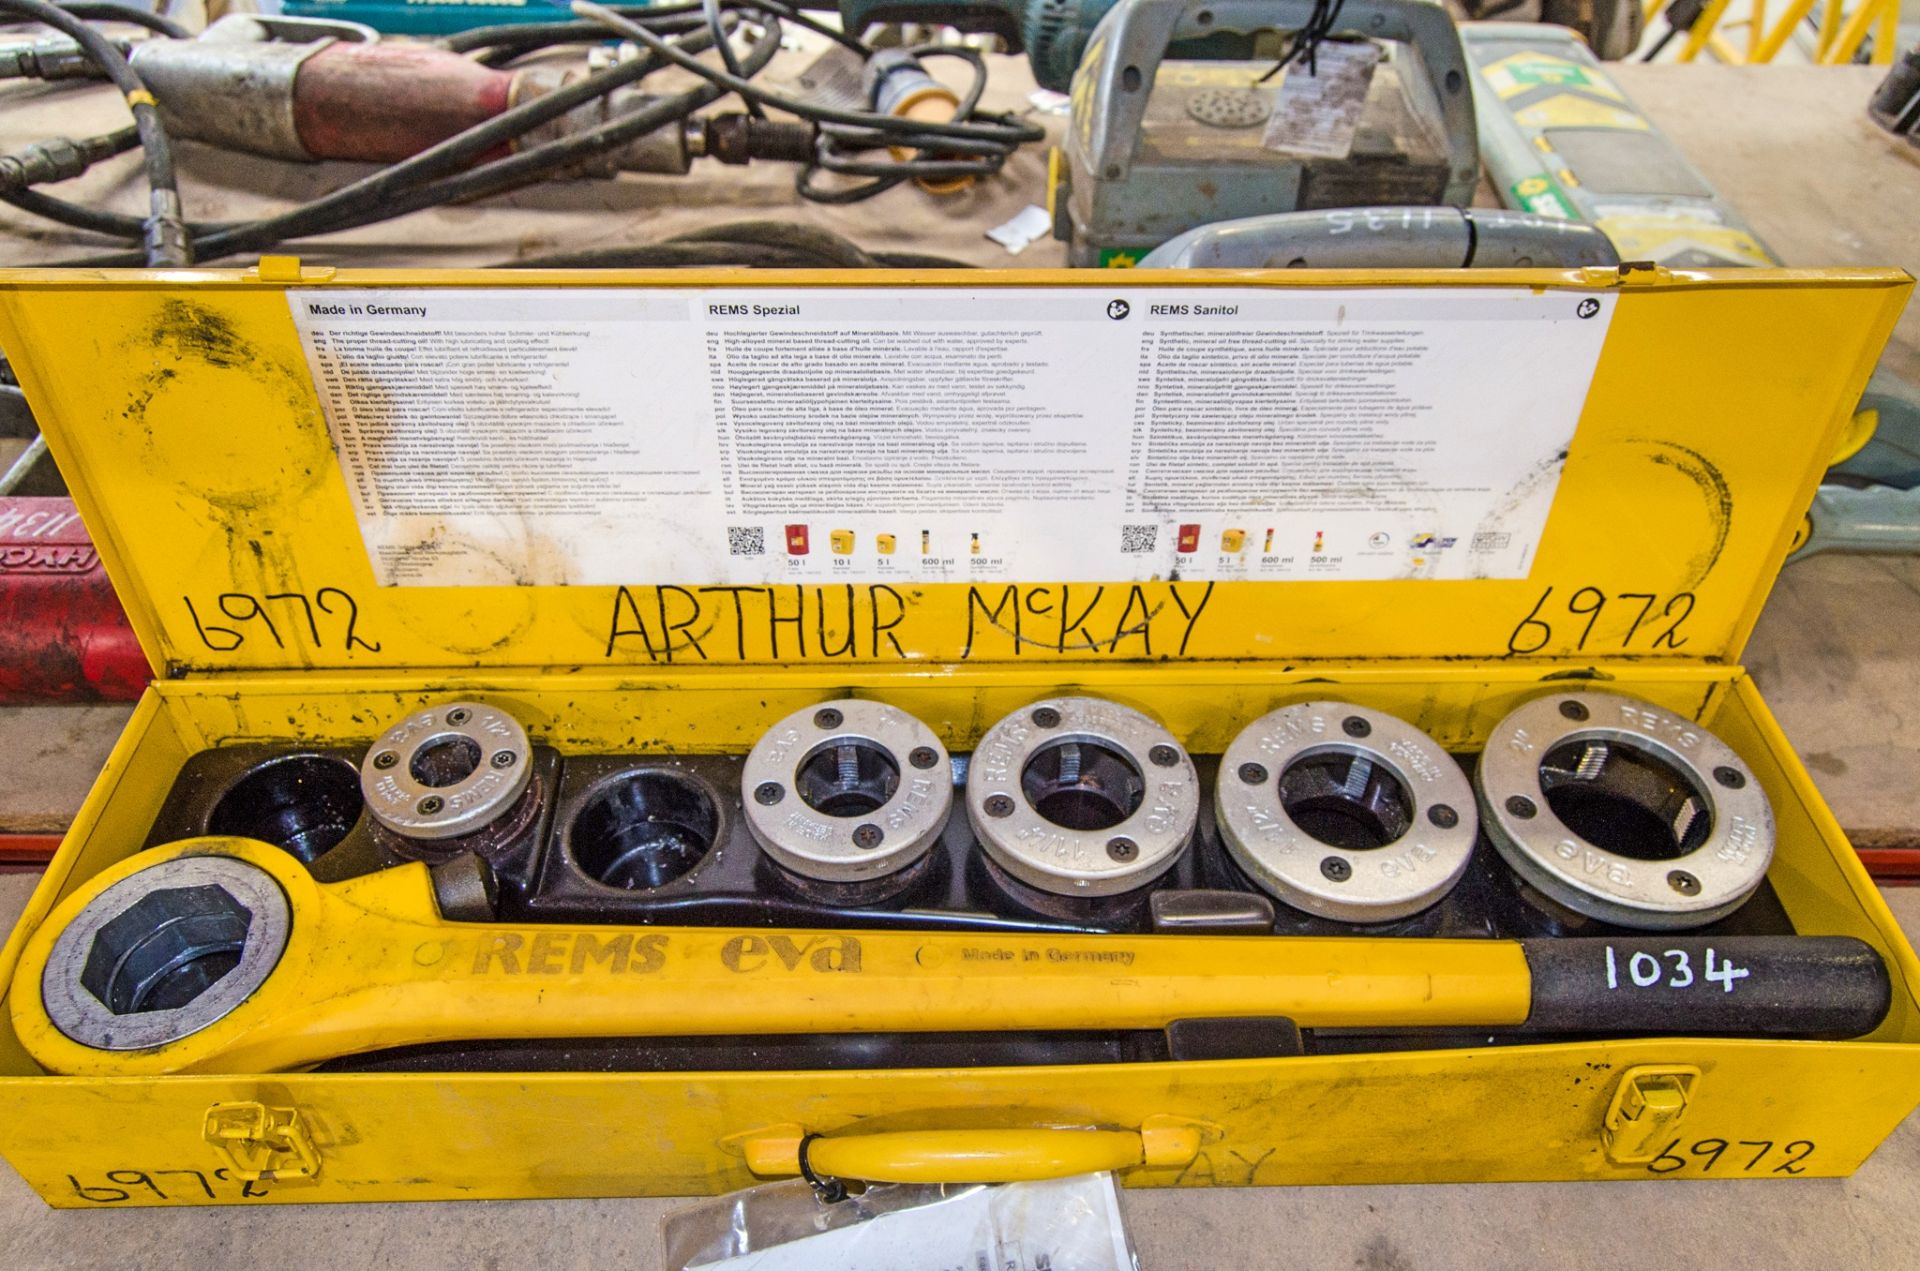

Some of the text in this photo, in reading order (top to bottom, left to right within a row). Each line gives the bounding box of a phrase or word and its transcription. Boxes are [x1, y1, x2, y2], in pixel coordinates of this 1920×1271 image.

[309, 304, 427, 318] Made in Germany
[709, 304, 800, 317] REMS Spezial
[1150, 304, 1238, 315] REMS Sanitol
[788, 558, 799, 566] 50
[833, 558, 845, 566] 10
[877, 558, 883, 566] 5
[922, 558, 939, 566] 600
[970, 558, 987, 566] 500
[183, 586, 380, 652] 6972
[606, 582, 1214, 659] ARTHUR McKAY
[1507, 586, 1697, 656] 6972
[1618, 704, 1701, 749] REMS
[1554, 838, 1633, 888] eva
[472, 934, 1136, 975] REMS eva Made in Germany
[1605, 945, 1749, 993] 1034
[1646, 1138, 1816, 1174] 6972
